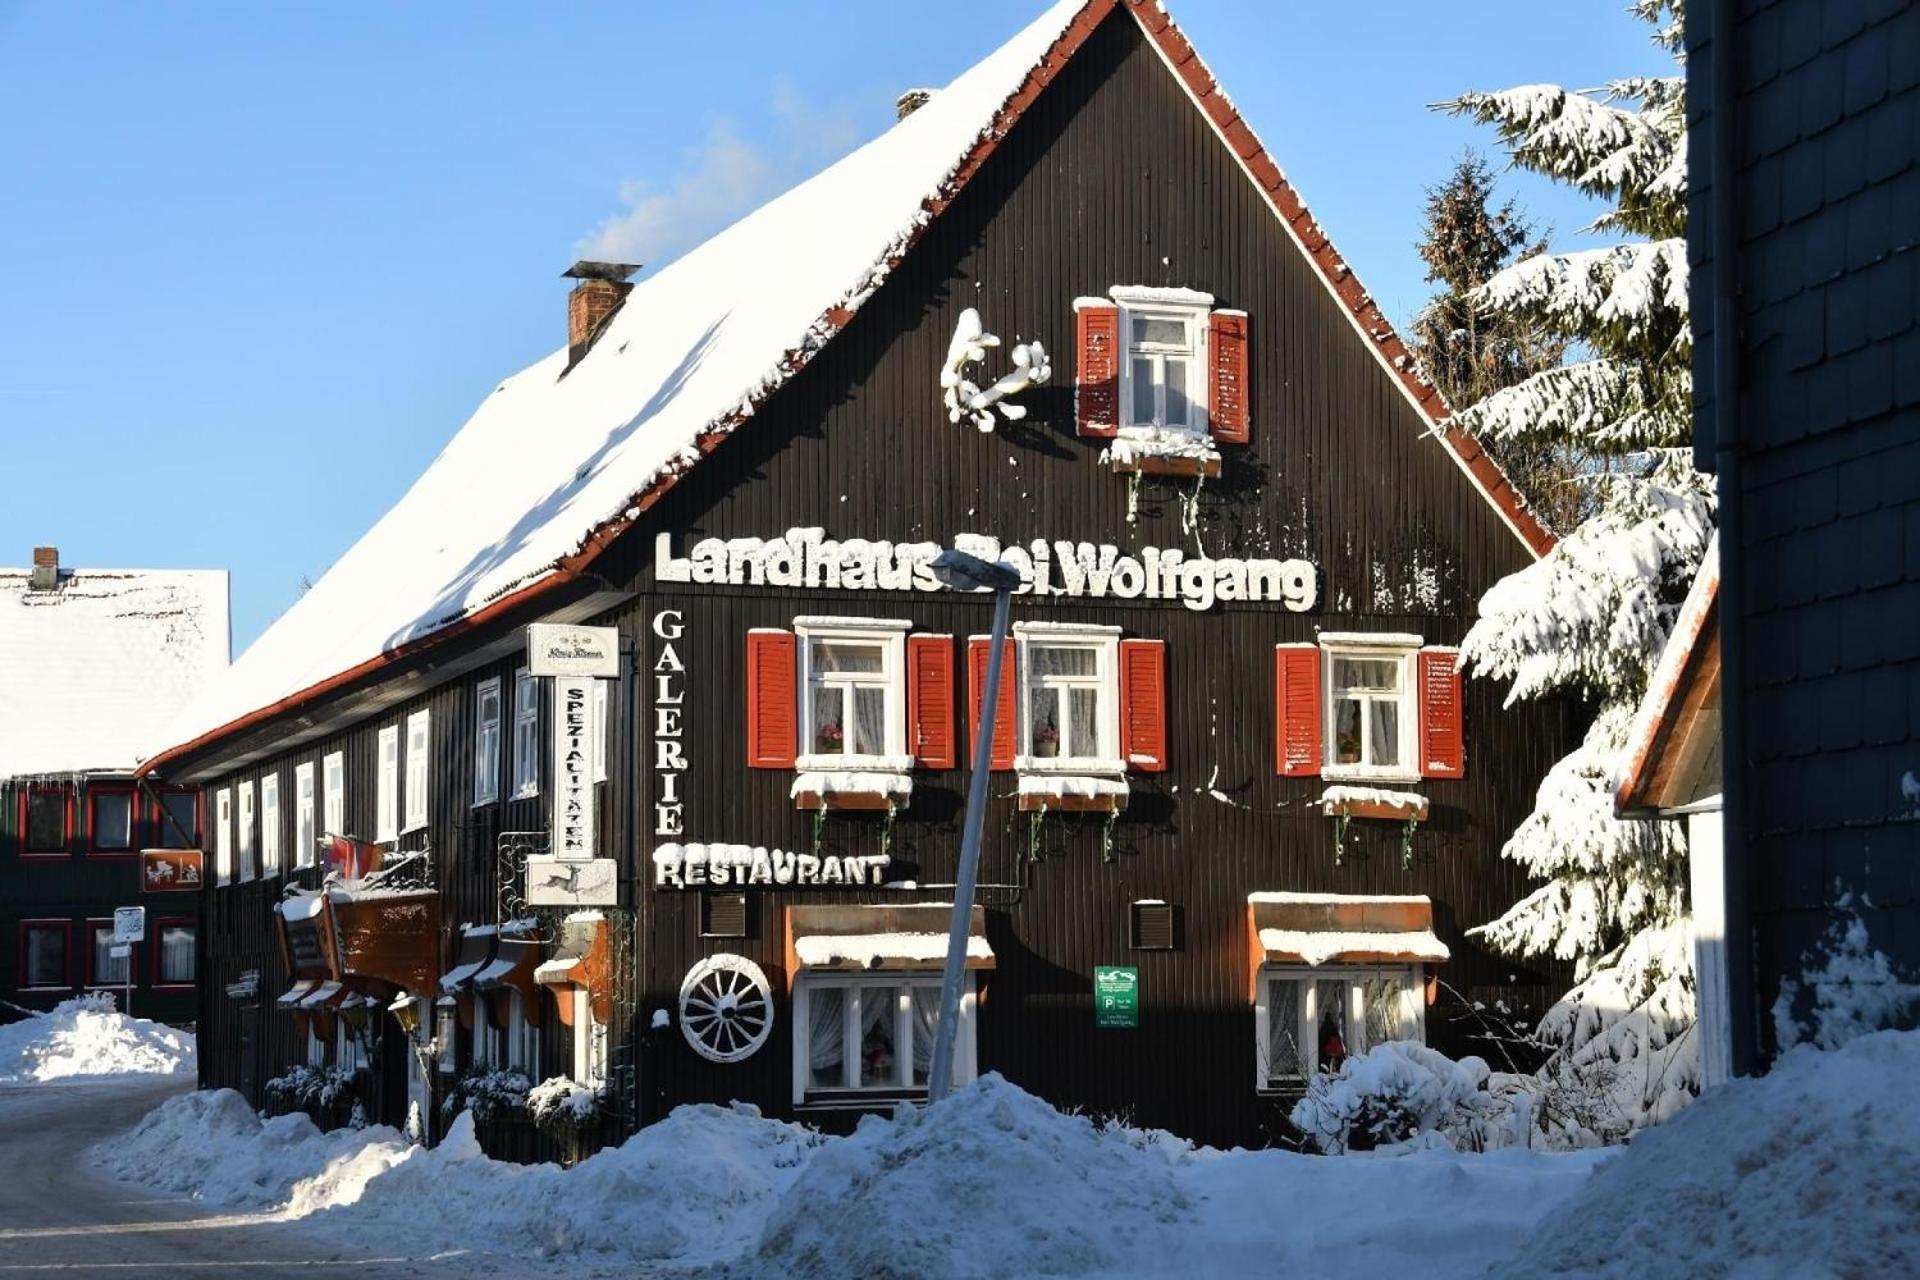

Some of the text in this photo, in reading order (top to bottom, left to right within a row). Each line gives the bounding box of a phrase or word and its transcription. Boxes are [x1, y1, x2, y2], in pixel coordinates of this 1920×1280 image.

[655, 528, 946, 592] Landhaus
[1054, 541, 1317, 611] Wolfgang
[653, 610, 688, 835] GALERIE
[654, 844, 891, 888] RESTAURANT
